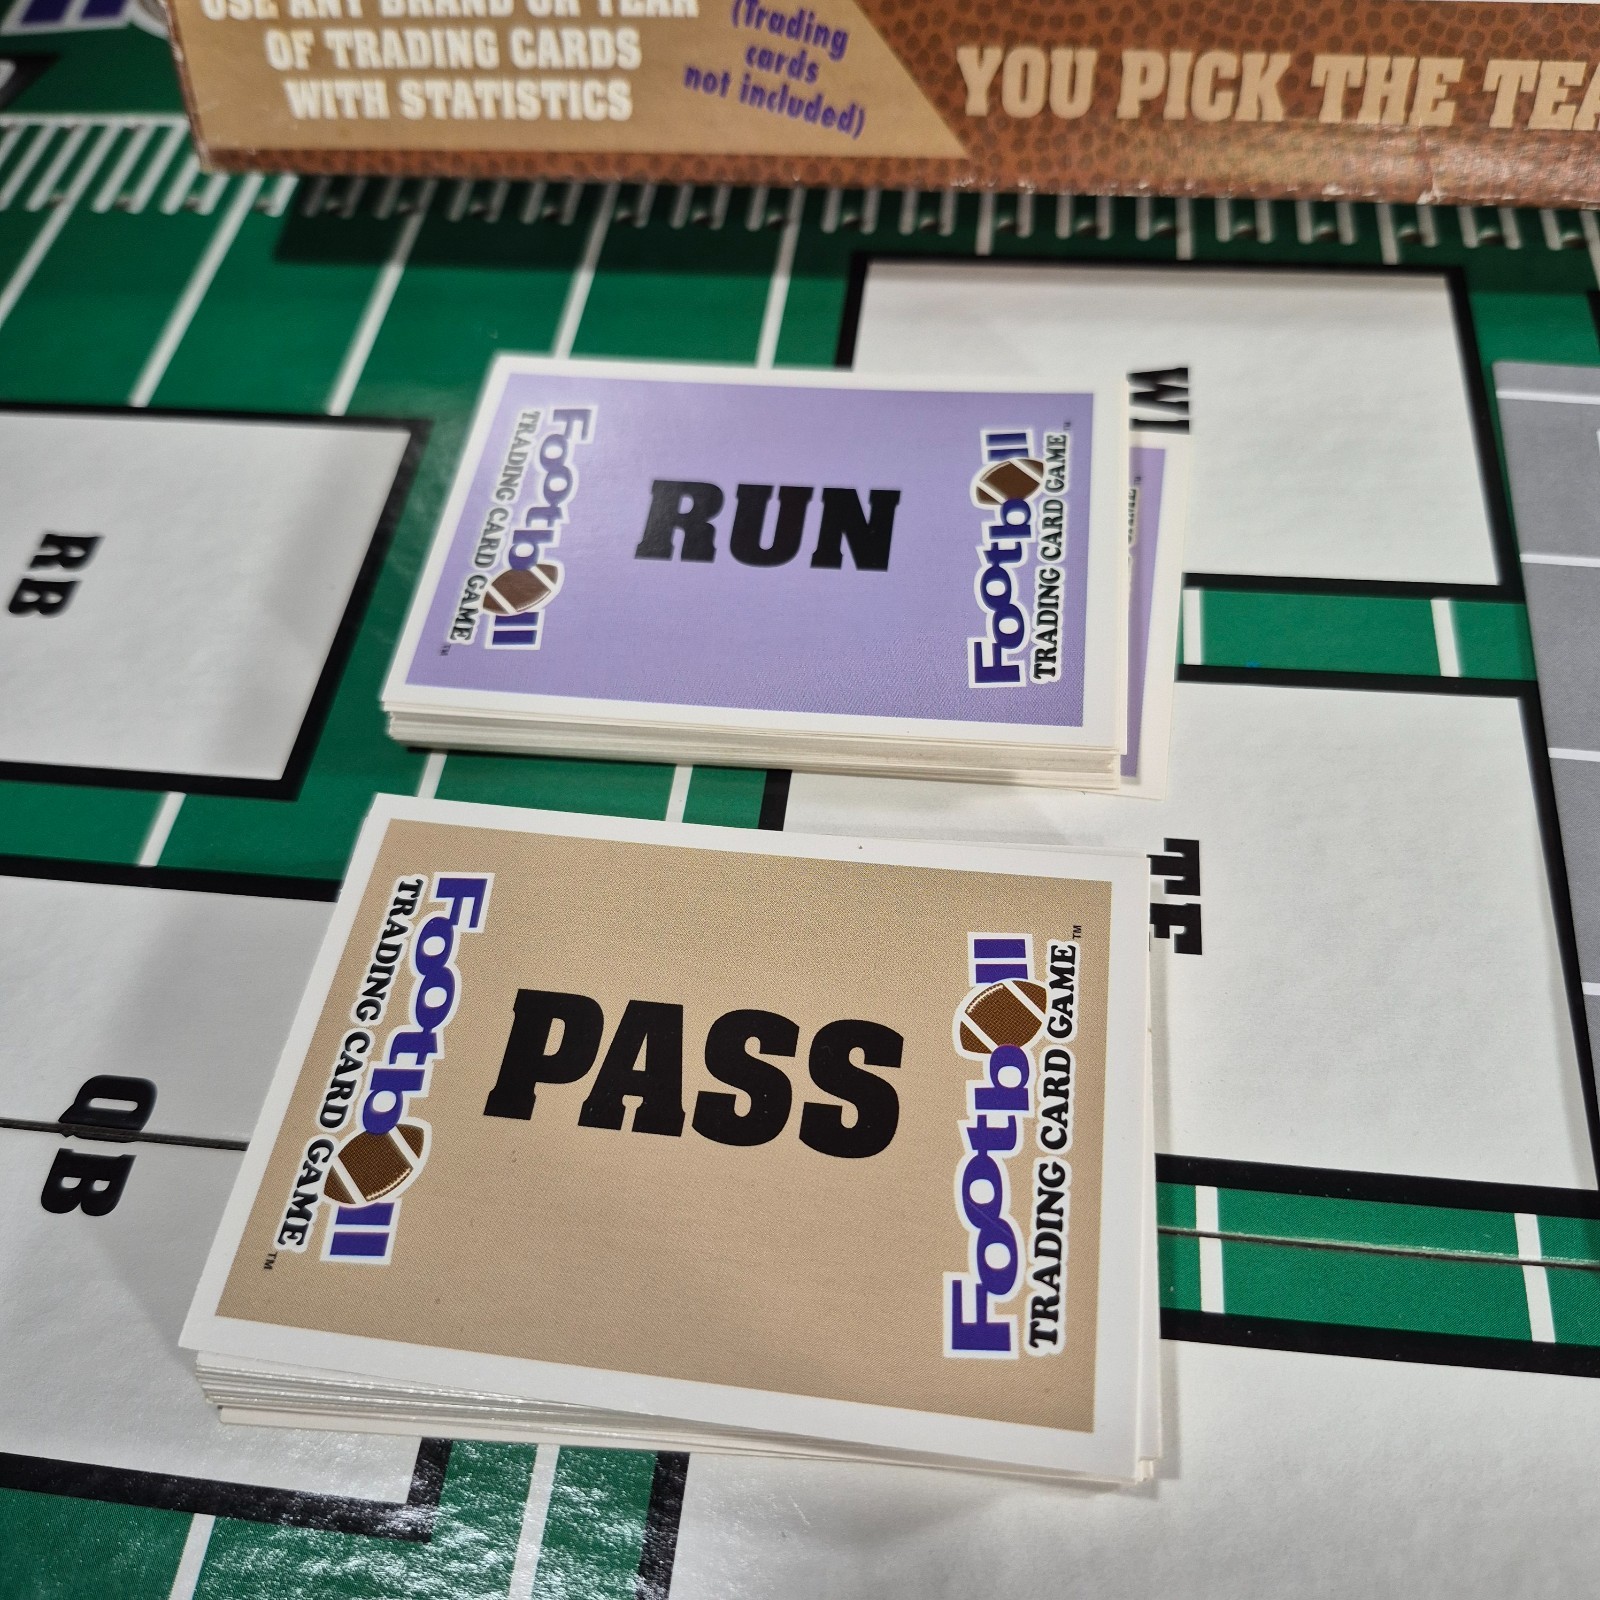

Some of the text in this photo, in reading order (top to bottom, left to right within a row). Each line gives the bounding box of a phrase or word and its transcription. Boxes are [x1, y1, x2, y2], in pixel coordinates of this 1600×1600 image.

[265, 27, 643, 71] OF TRADING CARDS
[732, 0, 849, 62] (Trading
[745, 46, 819, 85] cards
[283, 78, 634, 121] WITH STATISTICS
[684, 66, 865, 141] not included)
[956, 46, 1098, 119] YOU
[1116, 49, 1292, 122] PICK
[1310, 53, 1464, 128] THE
[495, 411, 541, 501] TRADING
[1044, 433, 1067, 494] GAME
[474, 506, 510, 569] CARD
[484, 407, 593, 647] Footbll
[634, 479, 902, 572] RUN
[974, 432, 1045, 684] Footbll
[1038, 499, 1065, 562] CARD
[8, 532, 104, 617] RB
[449, 573, 489, 642] GAME
[1033, 566, 1062, 681] TRADING
[355, 878, 424, 1023] TRADING
[1046, 944, 1077, 1039] GAME
[318, 1030, 371, 1130] CARD
[324, 877, 488, 1257] Footbll
[482, 987, 905, 1160] PASS
[1040, 1047, 1072, 1150] CARD
[40, 1073, 158, 1217] QB
[276, 1137, 335, 1247] GAME
[951, 938, 1047, 1352] Footbll
[1028, 1161, 1066, 1350] TRADING
